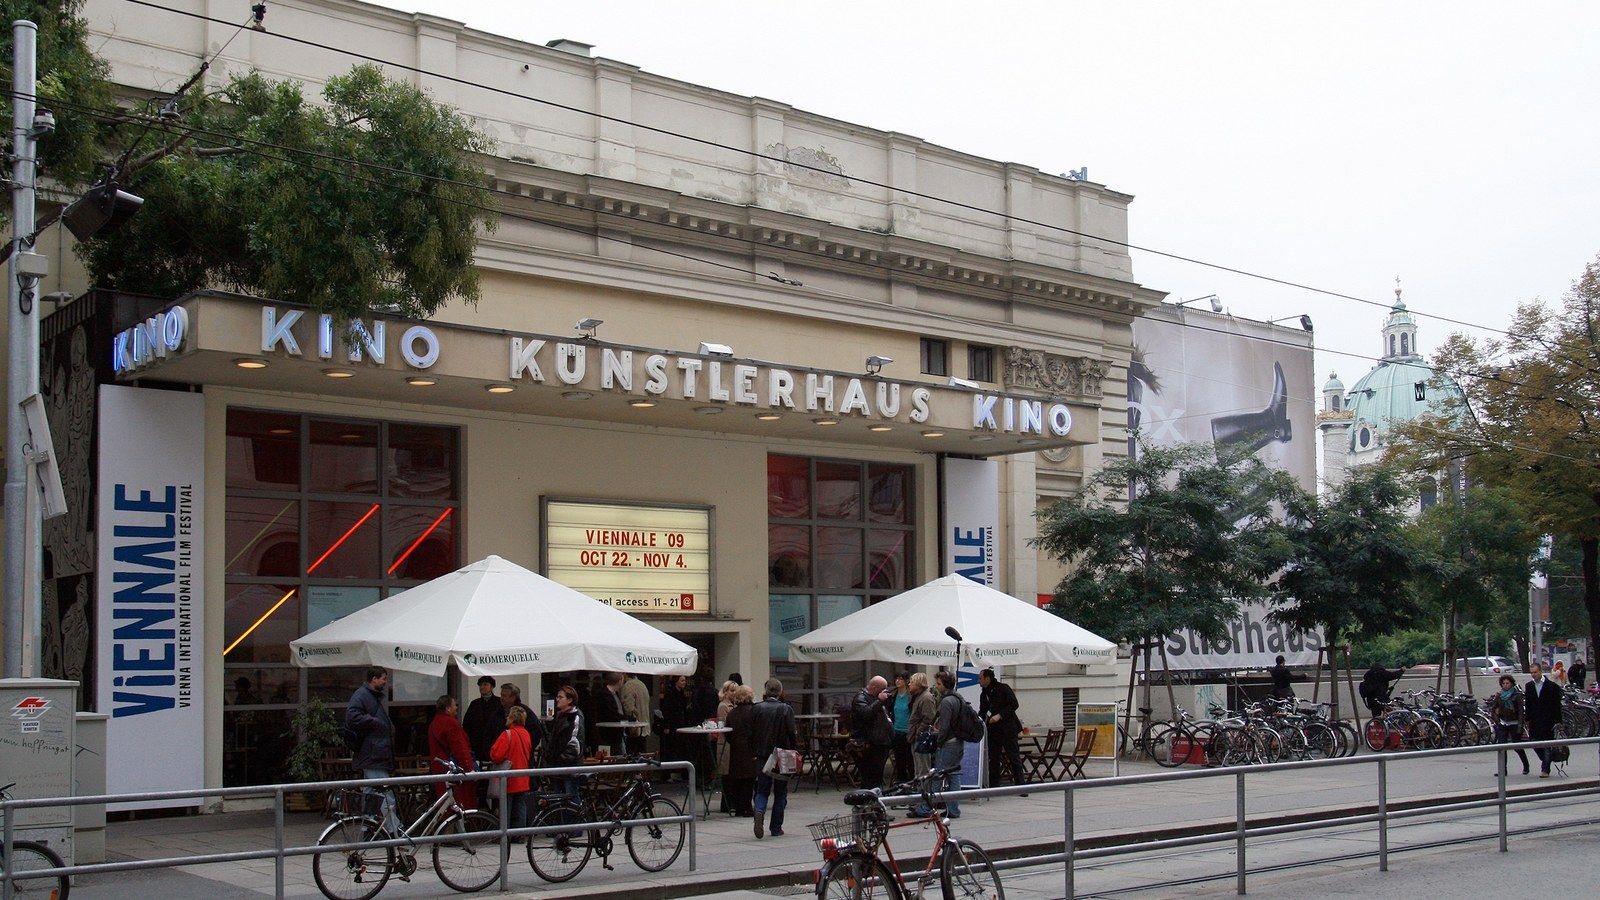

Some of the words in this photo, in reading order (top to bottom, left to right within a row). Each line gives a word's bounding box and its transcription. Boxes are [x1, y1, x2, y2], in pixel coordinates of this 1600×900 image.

[113, 305, 189, 374] KINO
[261, 306, 440, 369] KINO
[509, 337, 930, 424] KÜNSTLERHAUS
[973, 394, 1073, 437] KINO
[180, 484, 192, 535] FESTIVAL
[586, 529, 657, 547] VIENNALE
[179, 541, 191, 567] FILM
[580, 550, 607, 566] OCT
[643, 553, 670, 568] NOV
[675, 554, 687, 569] 4.
[615, 598, 649, 607] access
[179, 573, 191, 662] INTERNATIONAL
[403, 649, 442, 664] RÖMERQUELLE
[479, 652, 540, 665] RÖMERQUELLE
[637, 655, 689, 666] RÖMERQUELLE
[915, 648, 957, 658] RÖMERQUELLE
[179, 667, 191, 708] VIENNA
